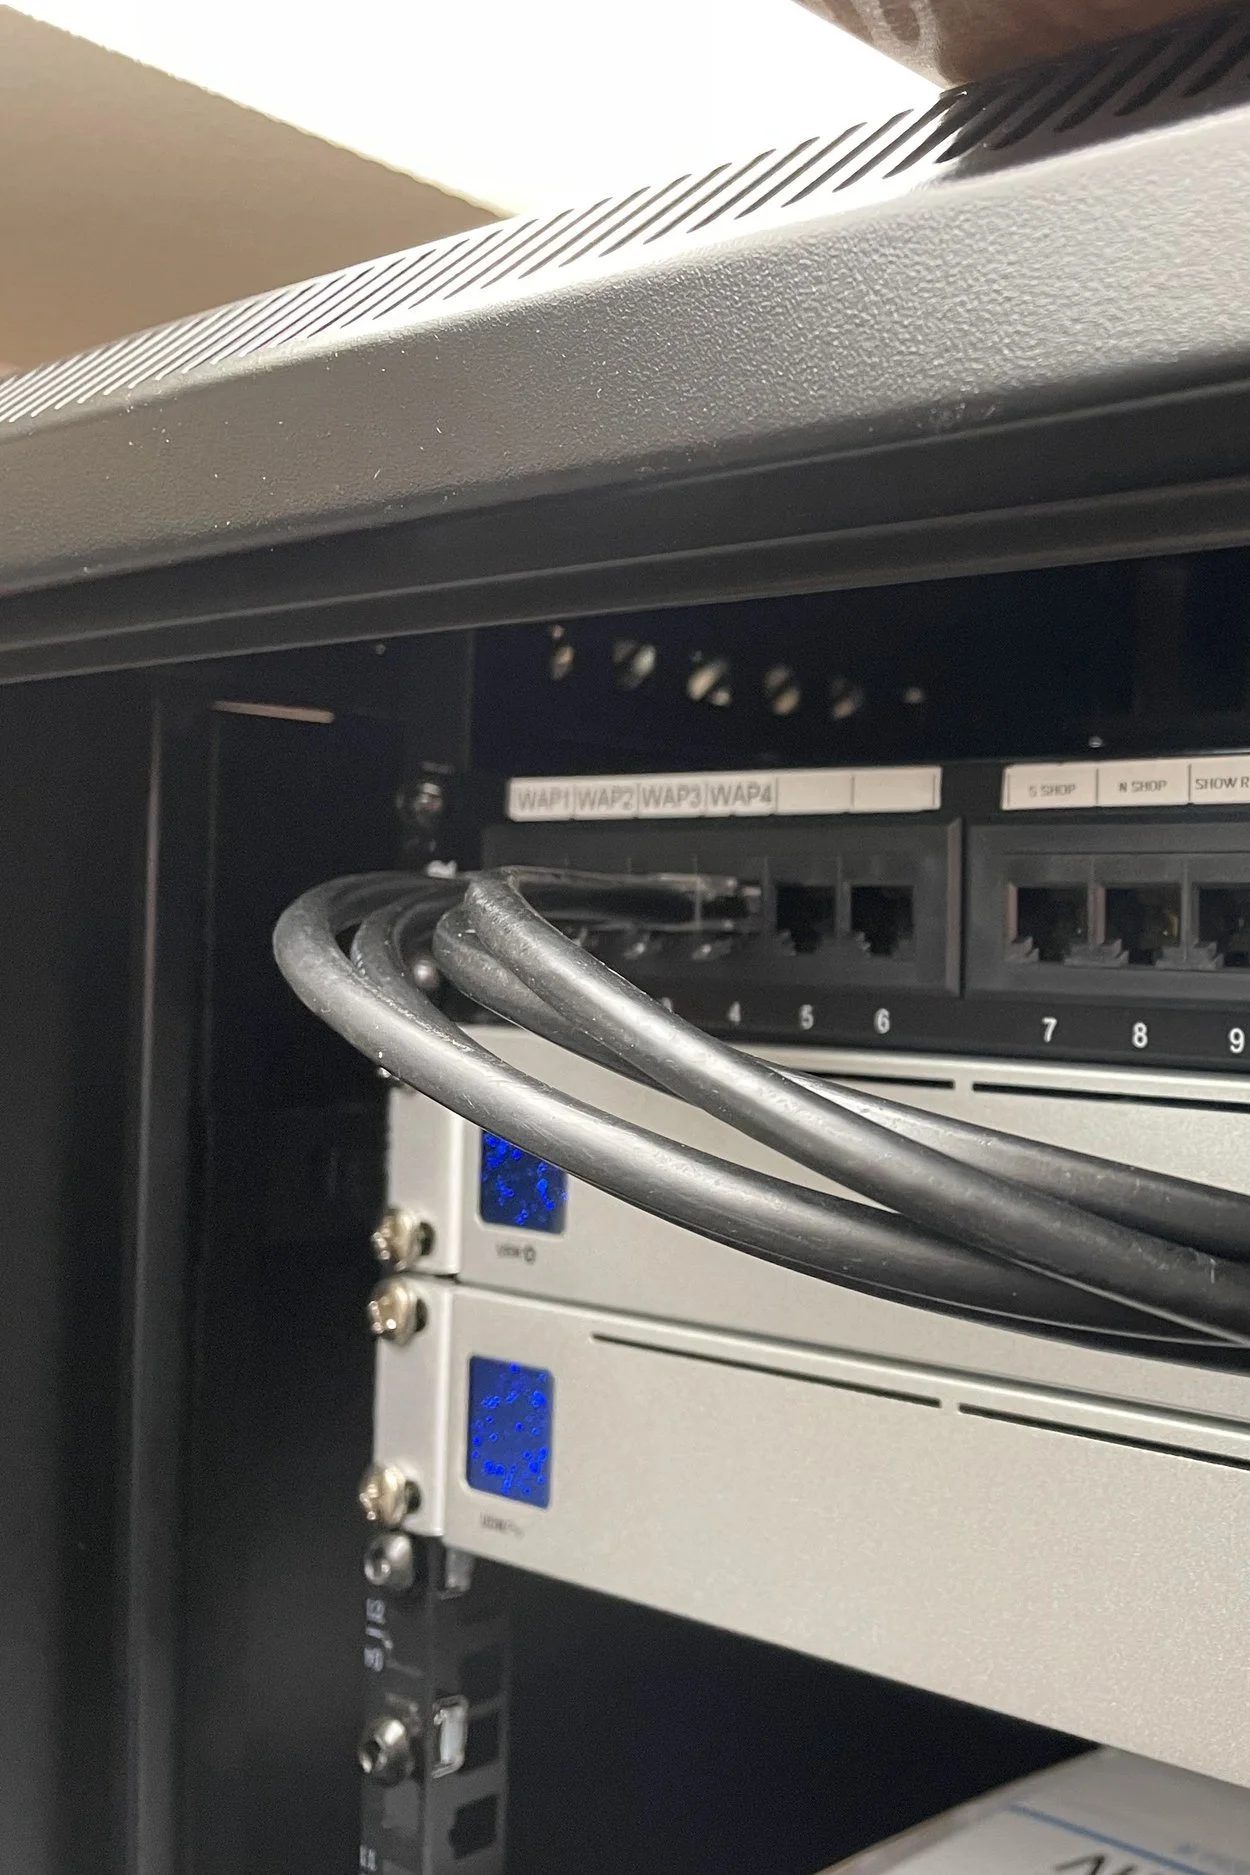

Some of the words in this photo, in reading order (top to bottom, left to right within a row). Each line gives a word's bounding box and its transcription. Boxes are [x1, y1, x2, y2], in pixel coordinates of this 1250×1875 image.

[577, 785, 634, 811] WAP2
[641, 783, 700, 809] WAP3
[710, 781, 772, 804] WAP4
[1040, 783, 1076, 796] SHOP
[1131, 779, 1168, 793] SHOP
[799, 1003, 815, 1030] 5
[874, 1008, 891, 1034] 6
[1042, 1017, 1057, 1043] 7
[1132, 1022, 1148, 1049] 8
[1229, 1027, 1245, 1054] 9
